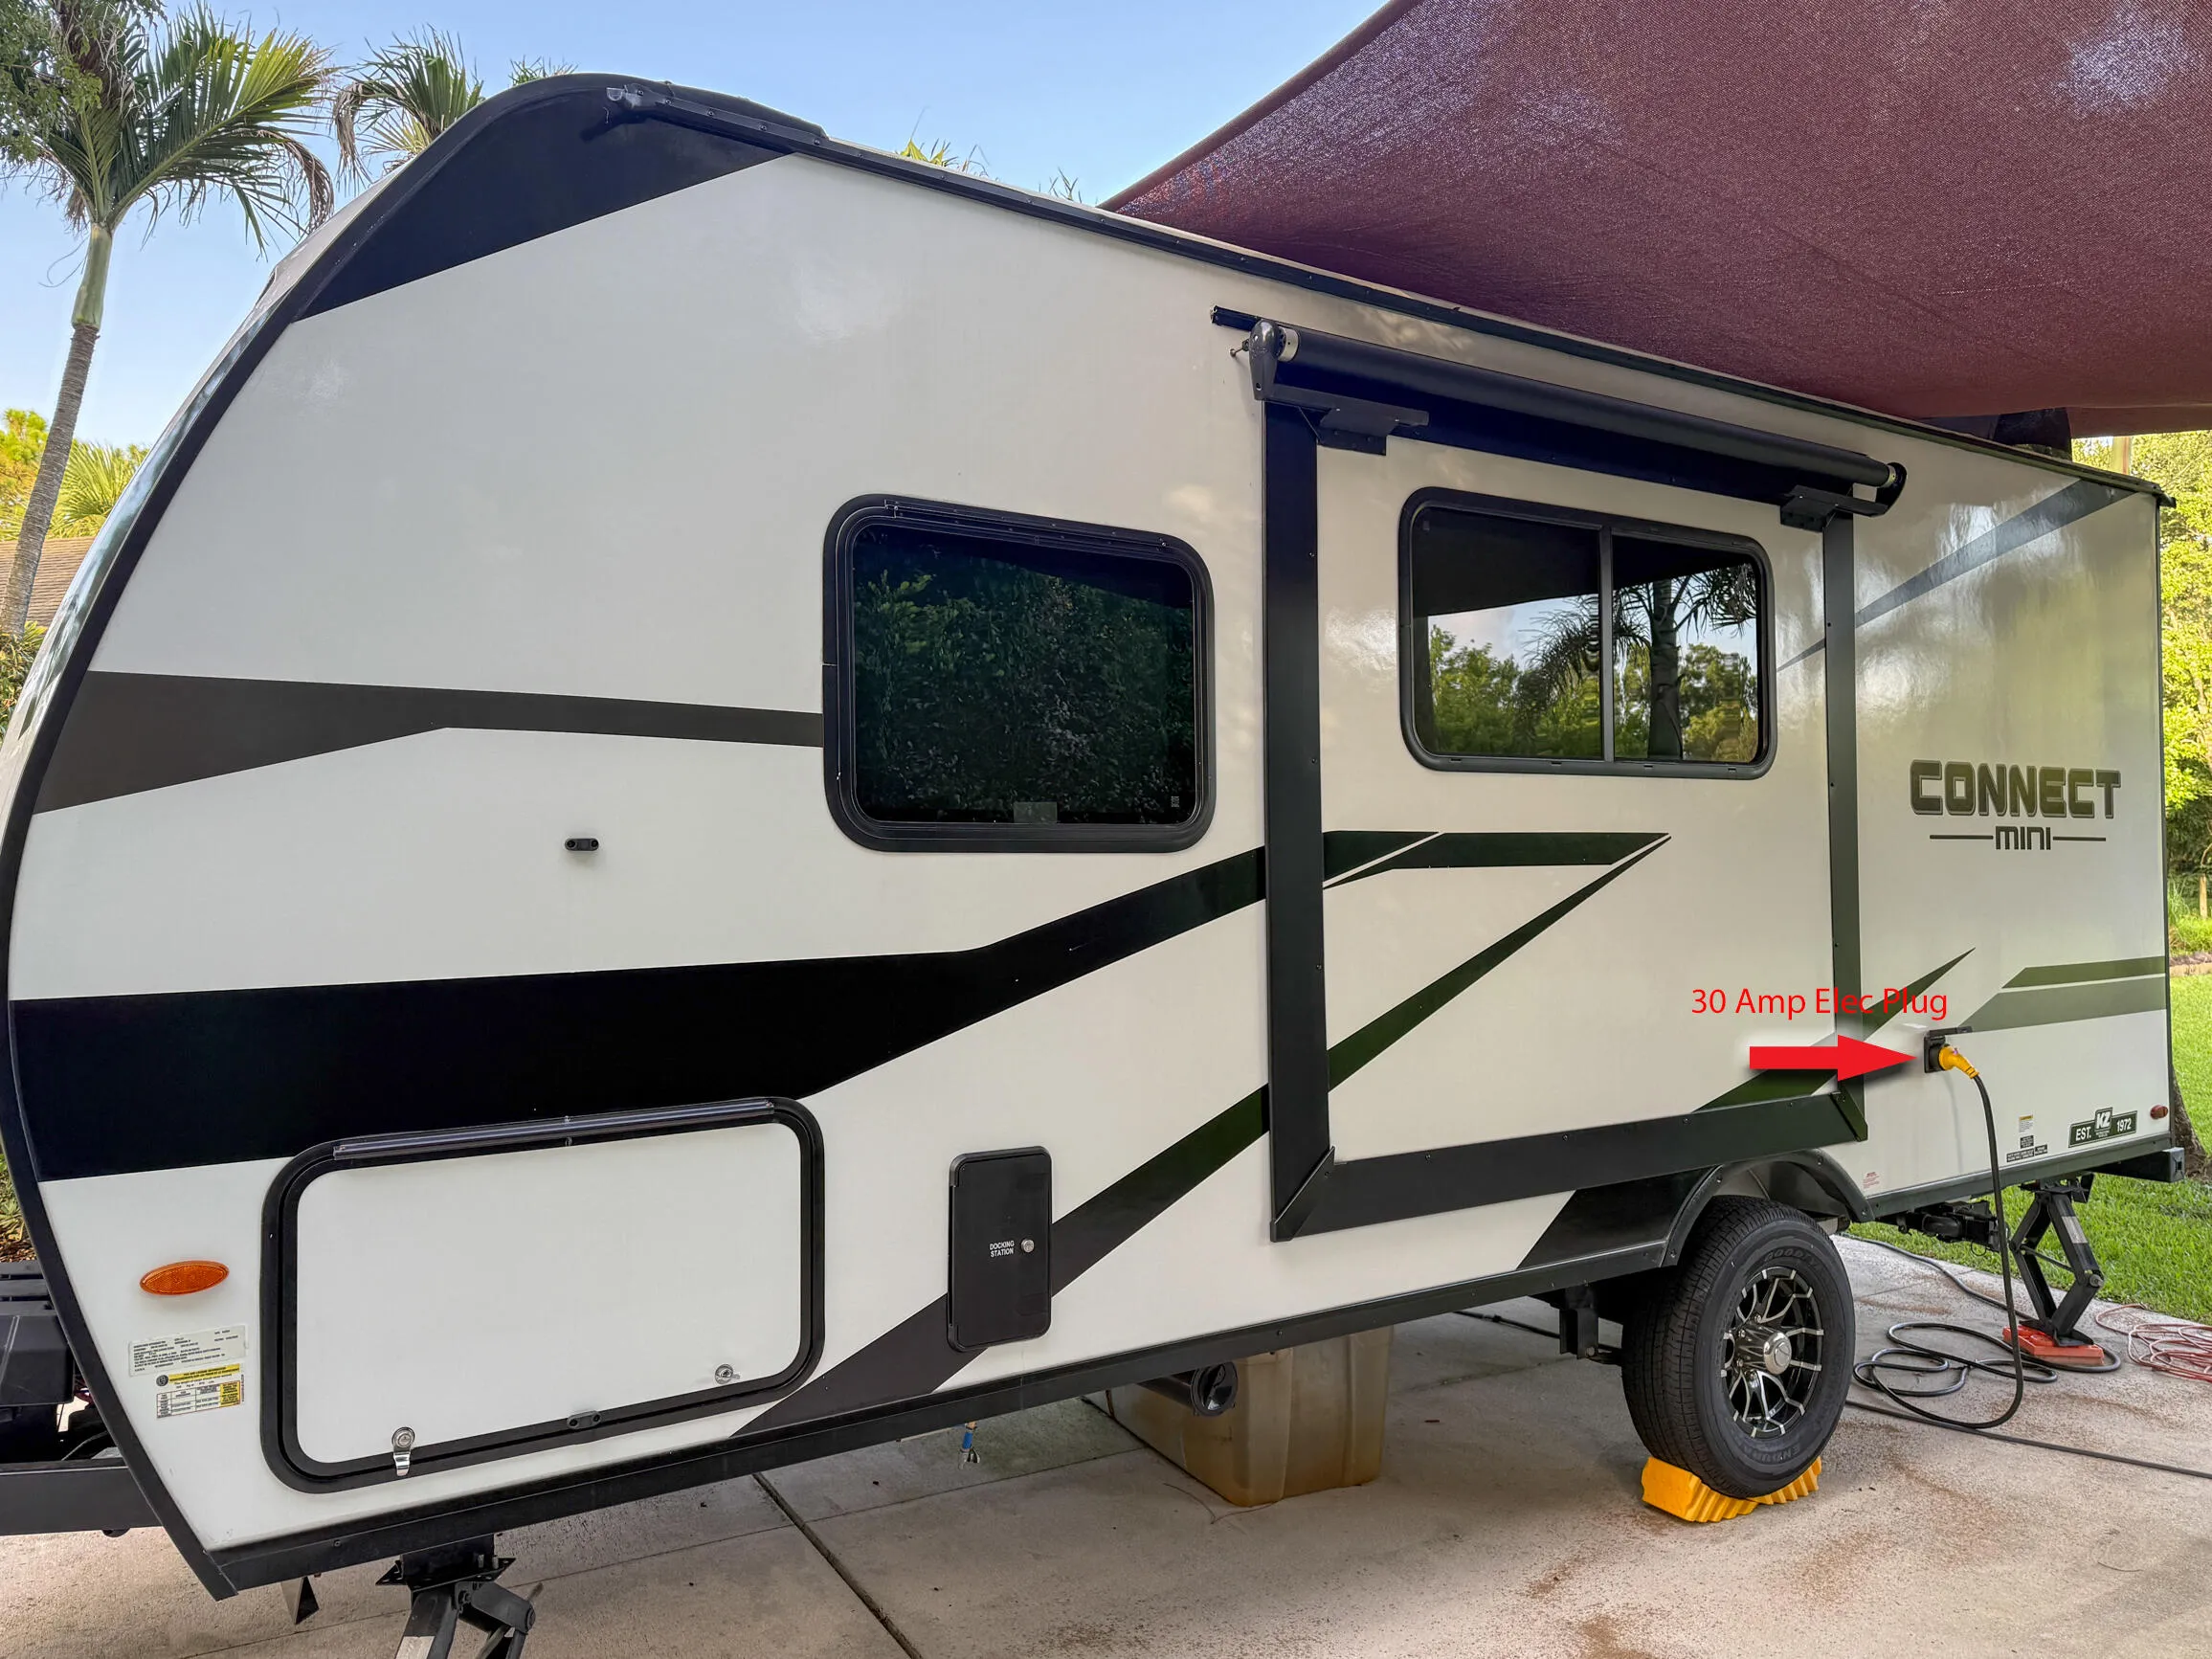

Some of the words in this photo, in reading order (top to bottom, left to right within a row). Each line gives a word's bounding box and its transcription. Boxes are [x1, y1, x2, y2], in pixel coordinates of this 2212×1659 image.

[1910, 759, 2121, 818] CONNECT
[2096, 1111, 2111, 1129] KZ
[2075, 1127, 2091, 1141] EST.
[2117, 1118, 2132, 1132] 1972
[990, 1241, 1015, 1250] DOCKING
[990, 1247, 1014, 1257] STATION
